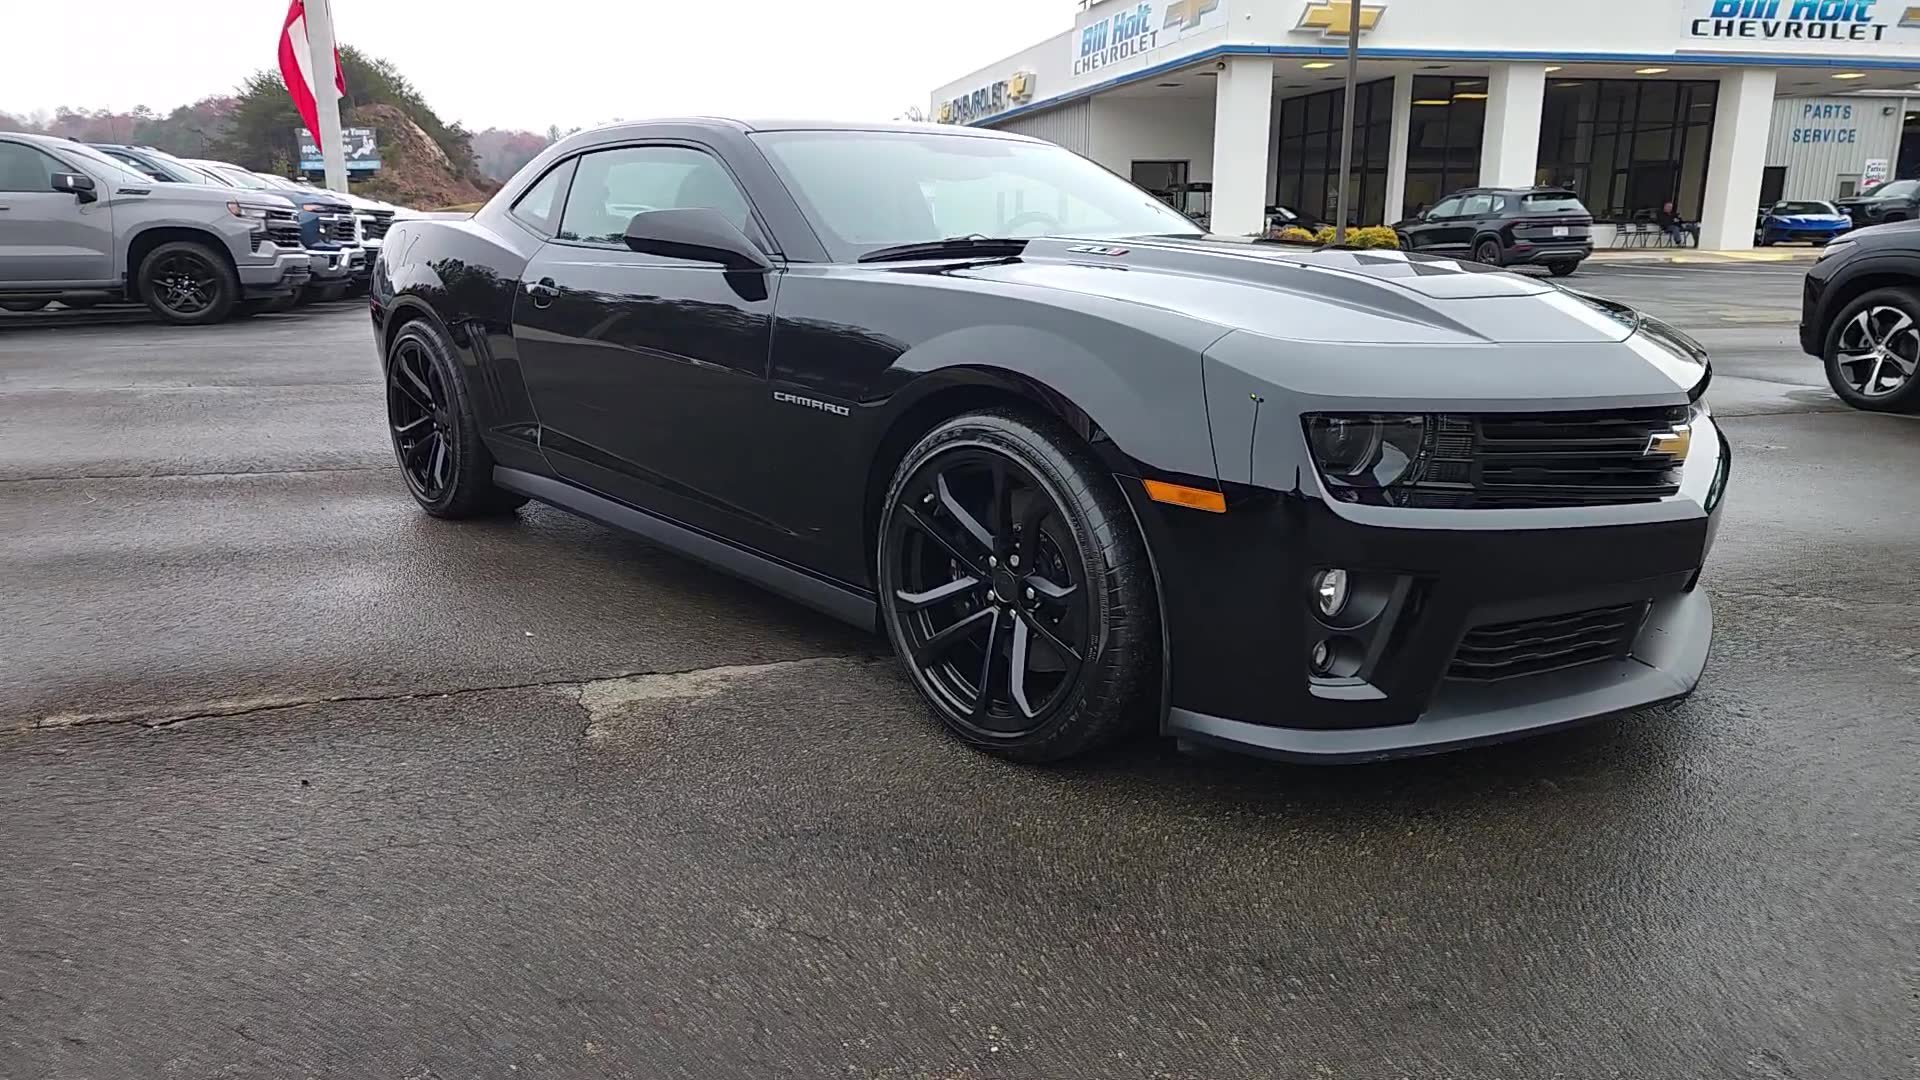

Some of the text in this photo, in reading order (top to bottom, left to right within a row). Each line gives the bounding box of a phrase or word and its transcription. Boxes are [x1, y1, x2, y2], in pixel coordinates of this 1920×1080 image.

[1710, 0, 1877, 22] Bill Holt
[1081, 3, 1152, 57] Bill Holt
[1691, 18, 1888, 41] CHEVROLET
[1074, 29, 1158, 76] CHEVROLET
[1803, 103, 1852, 120] PARTS
[1792, 128, 1857, 144] SERVICE
[773, 391, 850, 416] CAMARO
